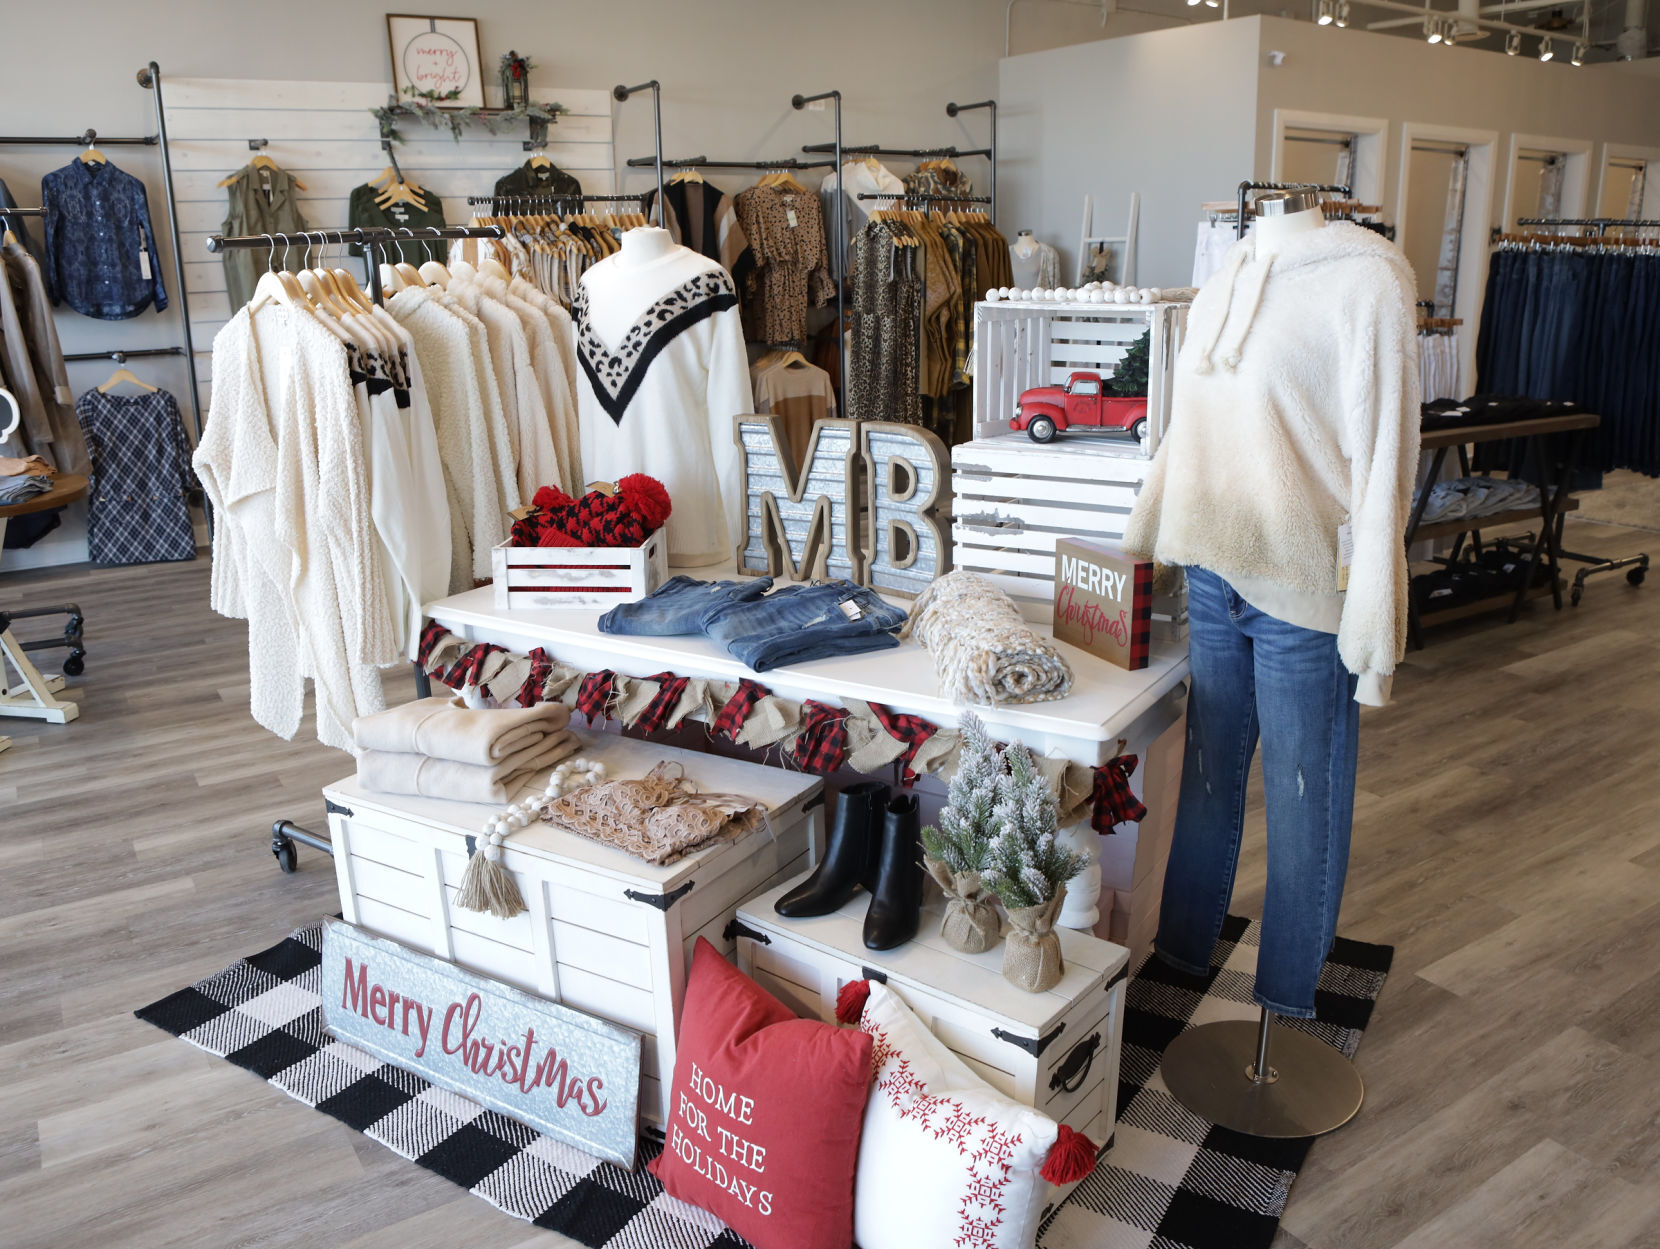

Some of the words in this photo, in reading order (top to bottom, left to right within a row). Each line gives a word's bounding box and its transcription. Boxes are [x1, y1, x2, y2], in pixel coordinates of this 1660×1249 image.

[416, 47, 458, 67] merry
[416, 64, 461, 89] bright
[1061, 554, 1126, 602] MERRY
[1056, 577, 1128, 647] Christmas
[341, 956, 433, 1058] Merry
[689, 1062, 755, 1125] HOME
[678, 1091, 712, 1142] FOR
[717, 1126, 767, 1173] THE
[671, 1123, 774, 1216] HOLIDAYS
